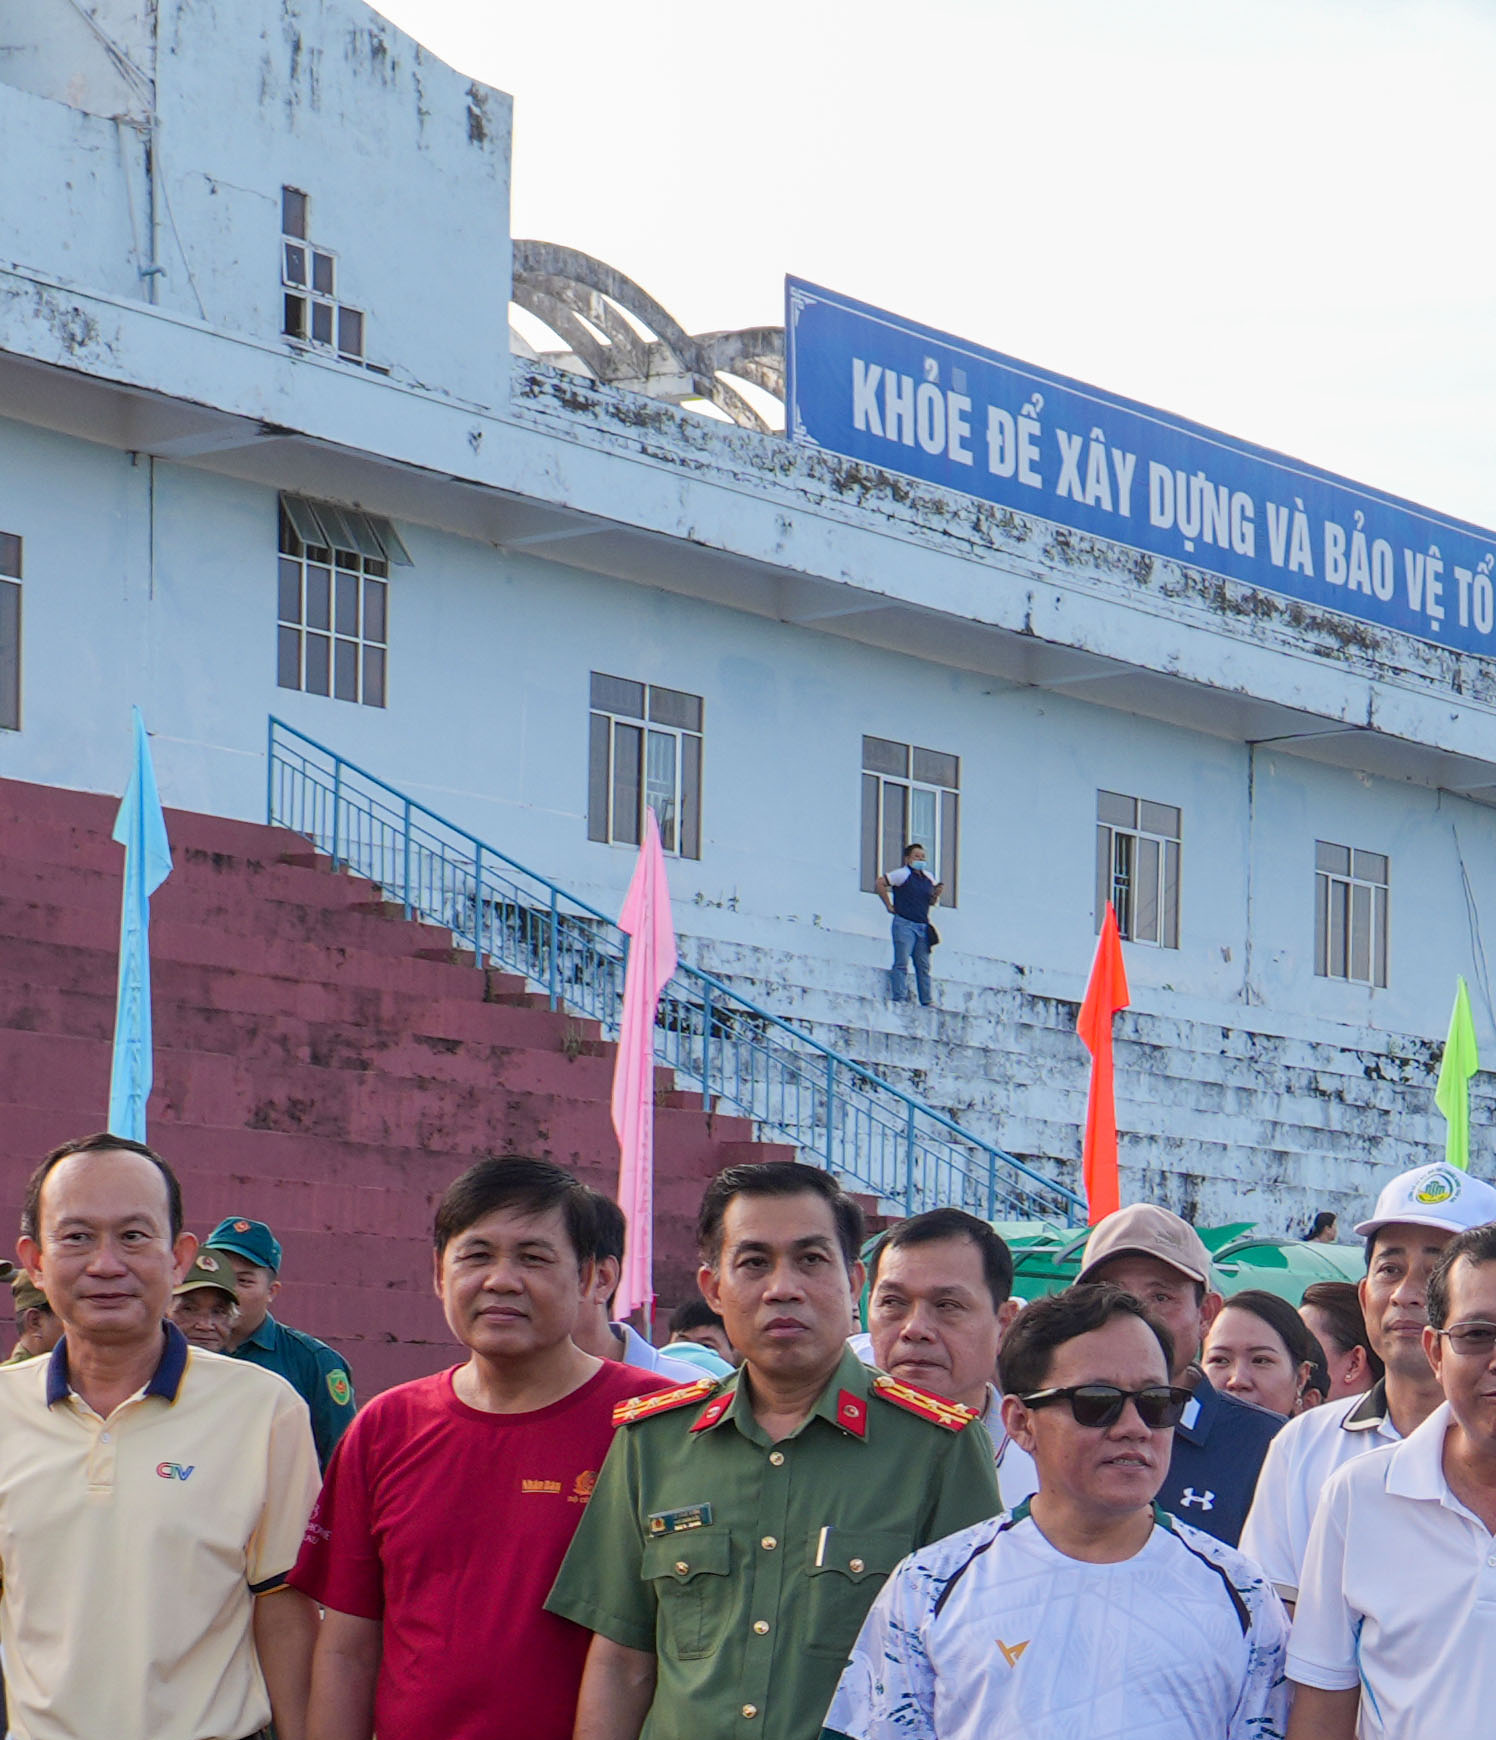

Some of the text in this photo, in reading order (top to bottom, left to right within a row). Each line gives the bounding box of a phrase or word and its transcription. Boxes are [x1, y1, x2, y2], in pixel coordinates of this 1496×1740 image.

[852, 355, 974, 466] KHỎE
[987, 392, 1043, 487] ĐỂ
[1056, 427, 1137, 515] XÂY
[1149, 459, 1256, 556] DỰNG
[1266, 495, 1314, 577] VÀ
[1324, 508, 1394, 602] BẢO
[1405, 543, 1446, 632] VỆ
[1455, 552, 1496, 634] TỔ
